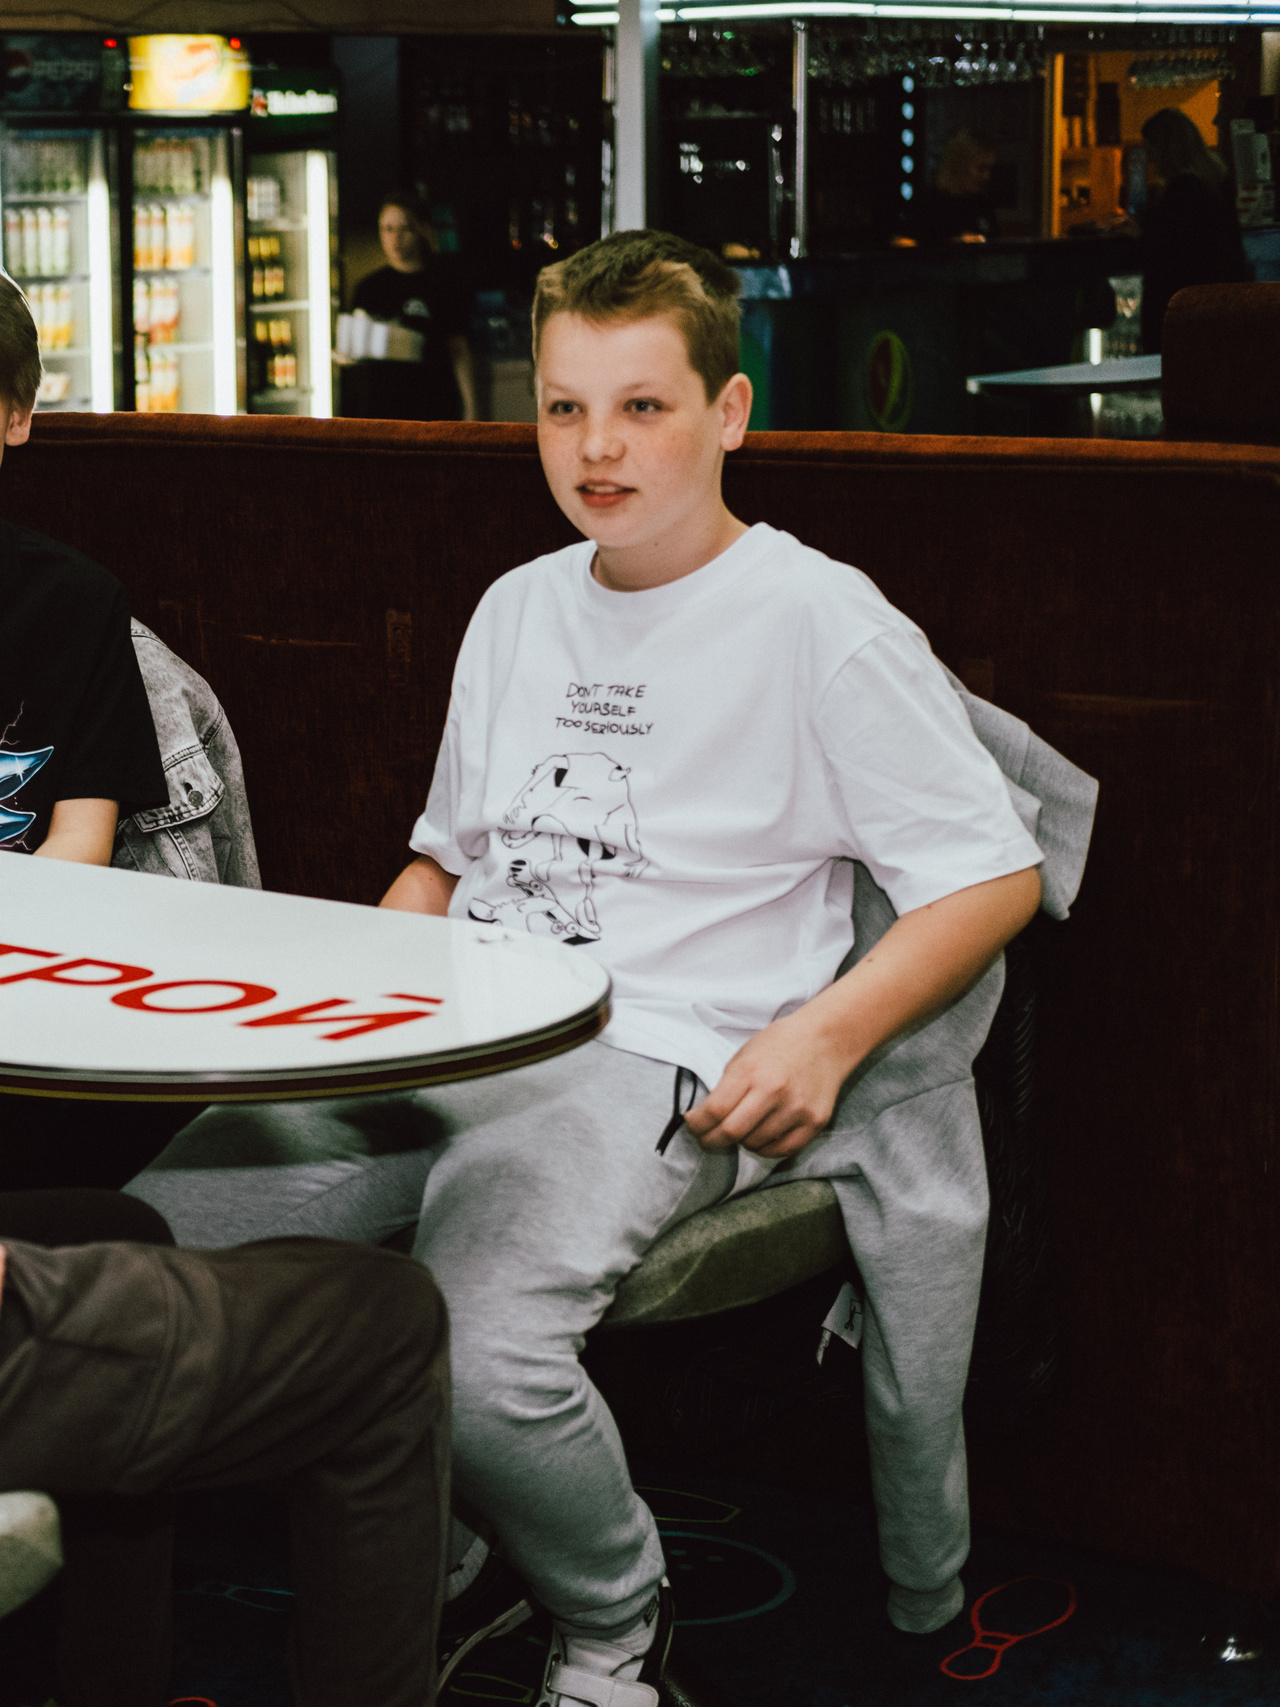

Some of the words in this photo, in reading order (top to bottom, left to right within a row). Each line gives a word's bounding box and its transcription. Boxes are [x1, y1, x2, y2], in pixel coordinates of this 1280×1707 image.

[607, 684, 646, 698] TAKE
[571, 700, 635, 717] YOURSELF
[556, 717, 582, 728] TOO
[584, 720, 654, 735] SERIOUSLY
